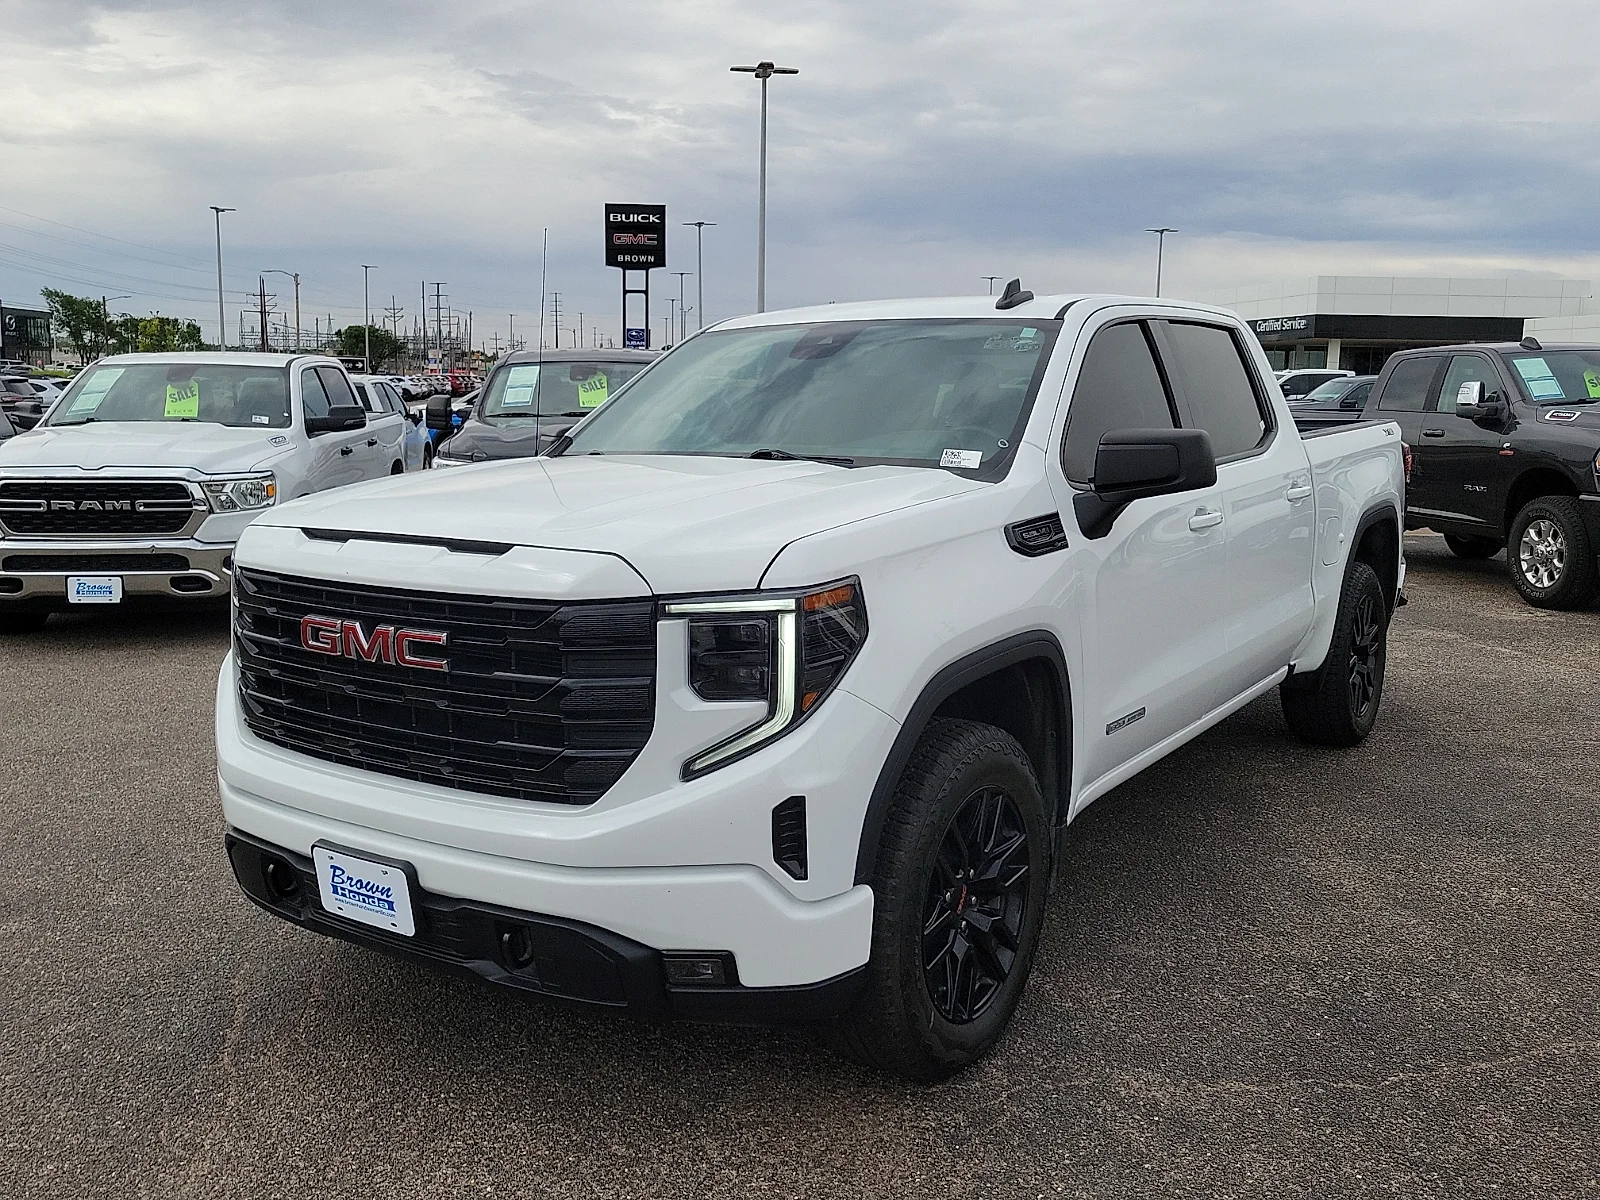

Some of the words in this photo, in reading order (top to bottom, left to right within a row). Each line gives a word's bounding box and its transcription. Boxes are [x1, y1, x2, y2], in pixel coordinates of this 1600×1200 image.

[609, 213, 661, 222] BUICK
[613, 233, 657, 245] GMC
[617, 254, 655, 262] BROWN
[1256, 319, 1281, 332] Certified
[1282, 318, 1306, 330] Service
[580, 379, 606, 394] SALE
[168, 386, 197, 403] SALE
[50, 500, 131, 511] RAM
[300, 615, 448, 672] GMC
[329, 864, 394, 898] Brown
[336, 886, 389, 910] Honda
